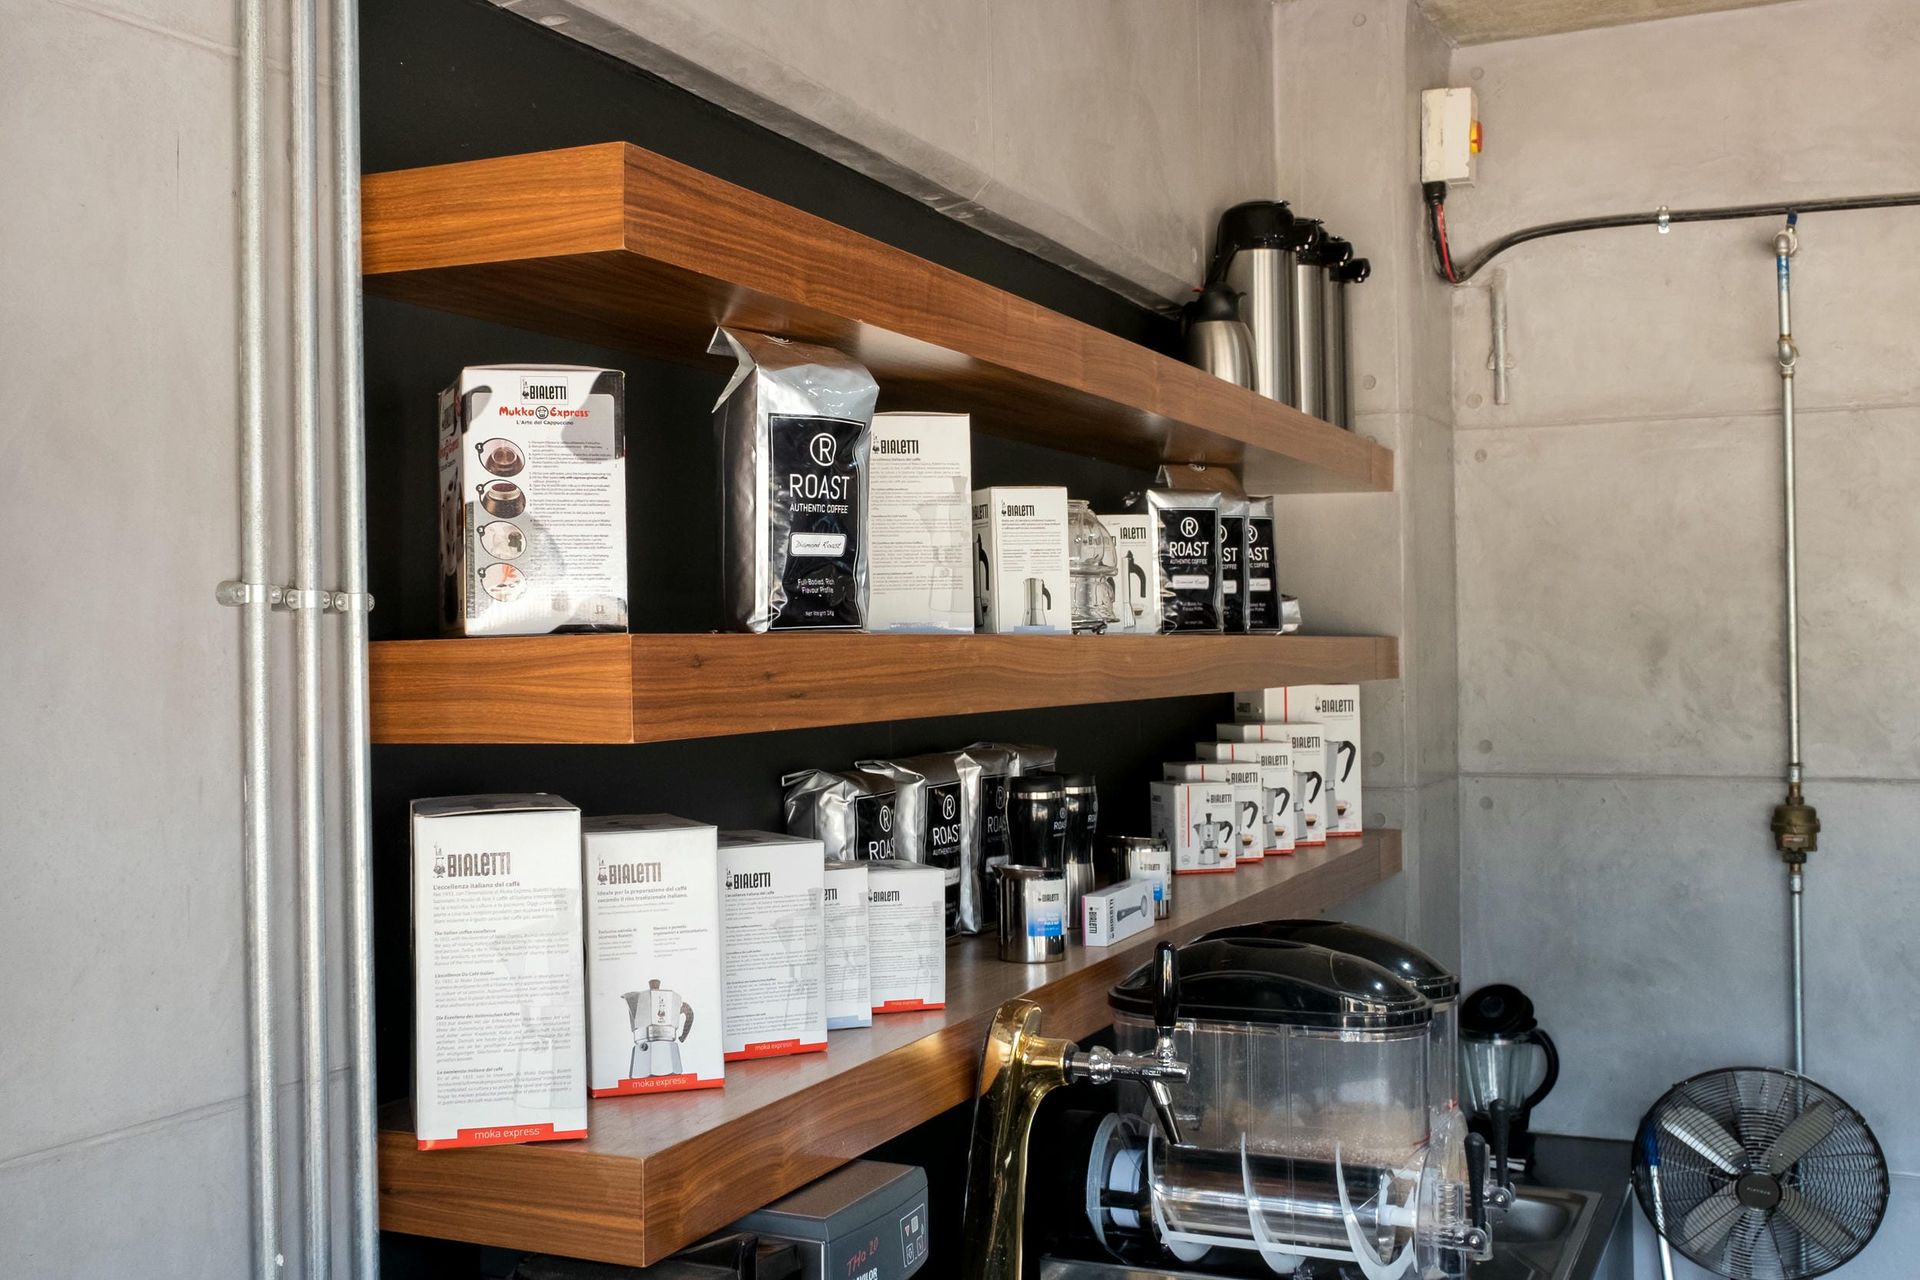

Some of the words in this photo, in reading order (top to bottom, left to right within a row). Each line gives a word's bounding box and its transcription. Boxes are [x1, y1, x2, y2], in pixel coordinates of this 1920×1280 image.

[529, 385, 567, 400] BIALETTI
[499, 406, 535, 417] Mukka
[550, 406, 589, 419] Express
[880, 439, 919, 454] BIALETTI
[789, 473, 850, 500] ROAST
[789, 503, 826, 513] AUTHENTIC
[826, 504, 849, 514] COFFEE
[1007, 504, 1035, 517] BIALETTI
[1120, 527, 1146, 540] IALETTI
[1169, 541, 1209, 557] ROAST
[1249, 547, 1269, 561] AST
[1322, 699, 1354, 712] BIALETTI
[1291, 736, 1320, 749] BIALETTI
[1261, 755, 1288, 766] BIALETTI
[1231, 772, 1258, 784] BIALETTI
[1210, 794, 1232, 803] BIALETTI
[868, 837, 895, 860] ROAS
[447, 851, 511, 877] BIALETTI
[609, 862, 662, 885] BIALETTI
[733, 872, 771, 890] BIALETTI
[873, 890, 900, 902] BIALETTI
[771, 1043, 793, 1051] express
[632, 1080, 655, 1088] moka
[656, 1077, 687, 1087] express
[474, 1129, 501, 1139] moka
[503, 1127, 540, 1139] express
